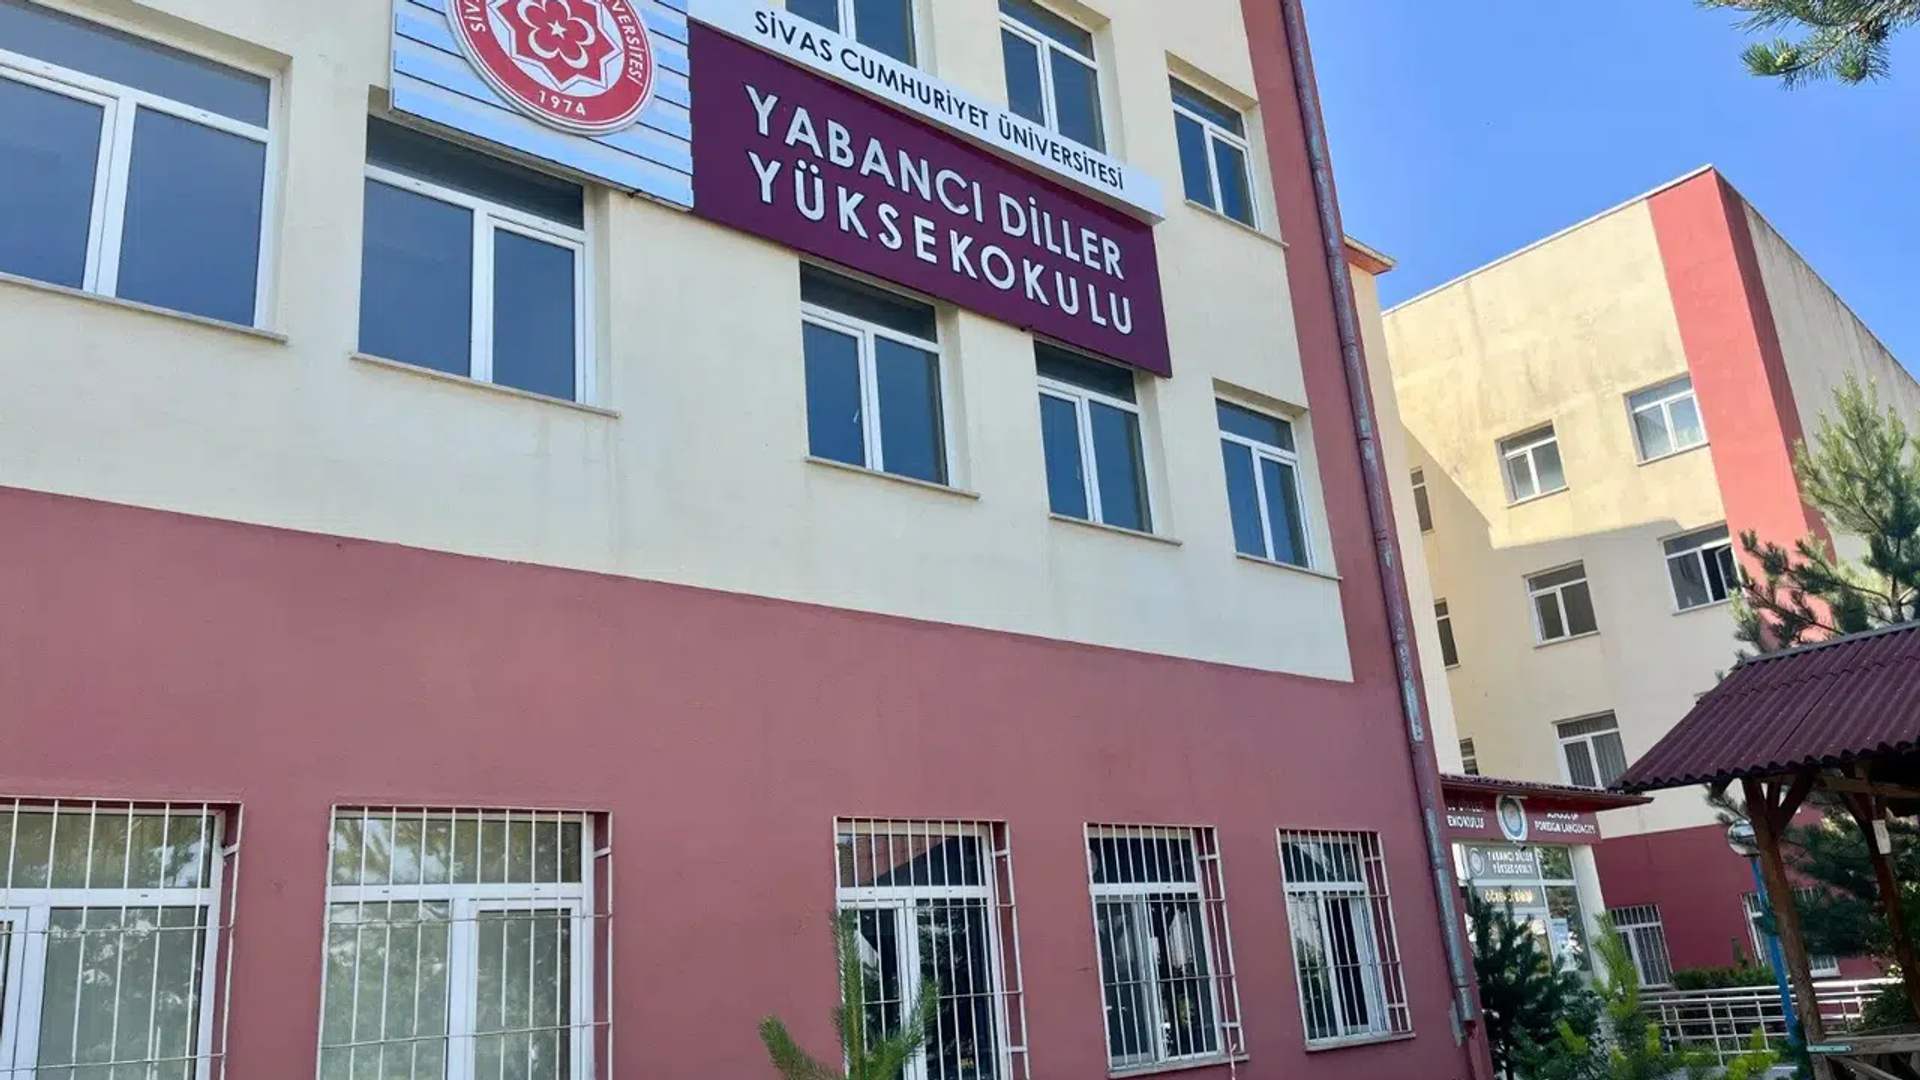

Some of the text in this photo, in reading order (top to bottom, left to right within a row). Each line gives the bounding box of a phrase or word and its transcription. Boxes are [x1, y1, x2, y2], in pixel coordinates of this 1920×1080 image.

[538, 91, 587, 116] 1974
[744, 84, 1126, 280] YABANCI DİLLER
[754, 10, 1125, 191] SİVAS CUMHURİYET ÜNİVERSİTESİ
[746, 150, 1134, 336] YÜKSEKOKULU
